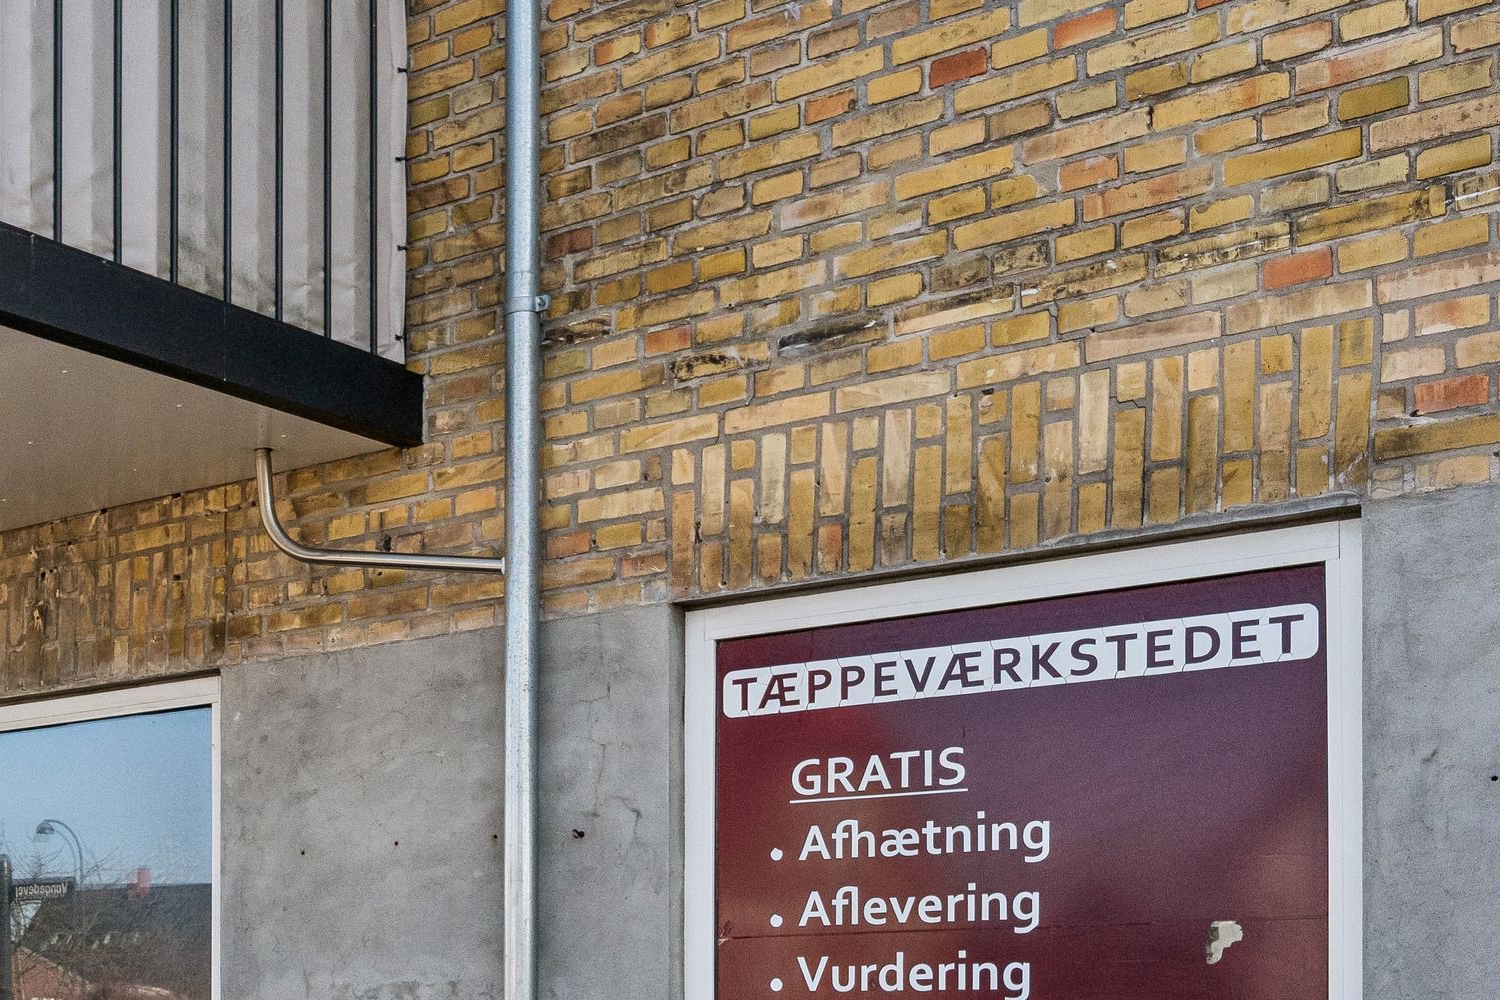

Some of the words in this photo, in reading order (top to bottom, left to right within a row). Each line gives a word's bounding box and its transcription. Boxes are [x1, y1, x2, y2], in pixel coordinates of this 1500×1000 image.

[731, 613, 1305, 712] TÆPPEVÆRKSTEDET
[791, 746, 968, 796] GRATIS
[798, 810, 1050, 863] Afhætning
[798, 882, 1040, 934] Aflevering
